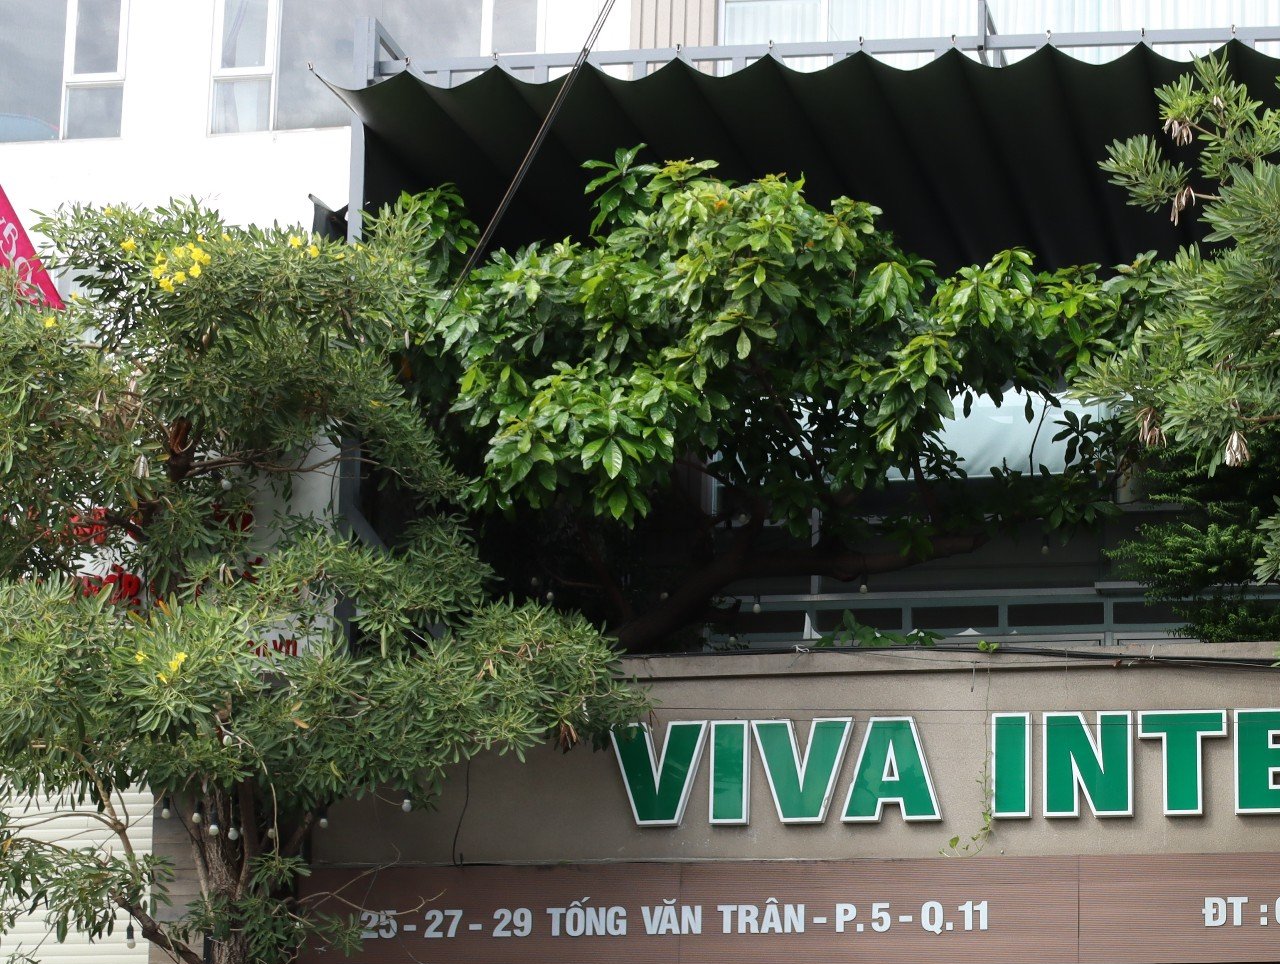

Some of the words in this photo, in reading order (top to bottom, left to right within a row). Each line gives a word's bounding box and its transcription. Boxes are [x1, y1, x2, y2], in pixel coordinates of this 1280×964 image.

[609, 716, 943, 827] VIVA
[546, 896, 628, 937] TỐNG
[641, 898, 702, 936] VĂN
[716, 896, 805, 934] TRÂN
